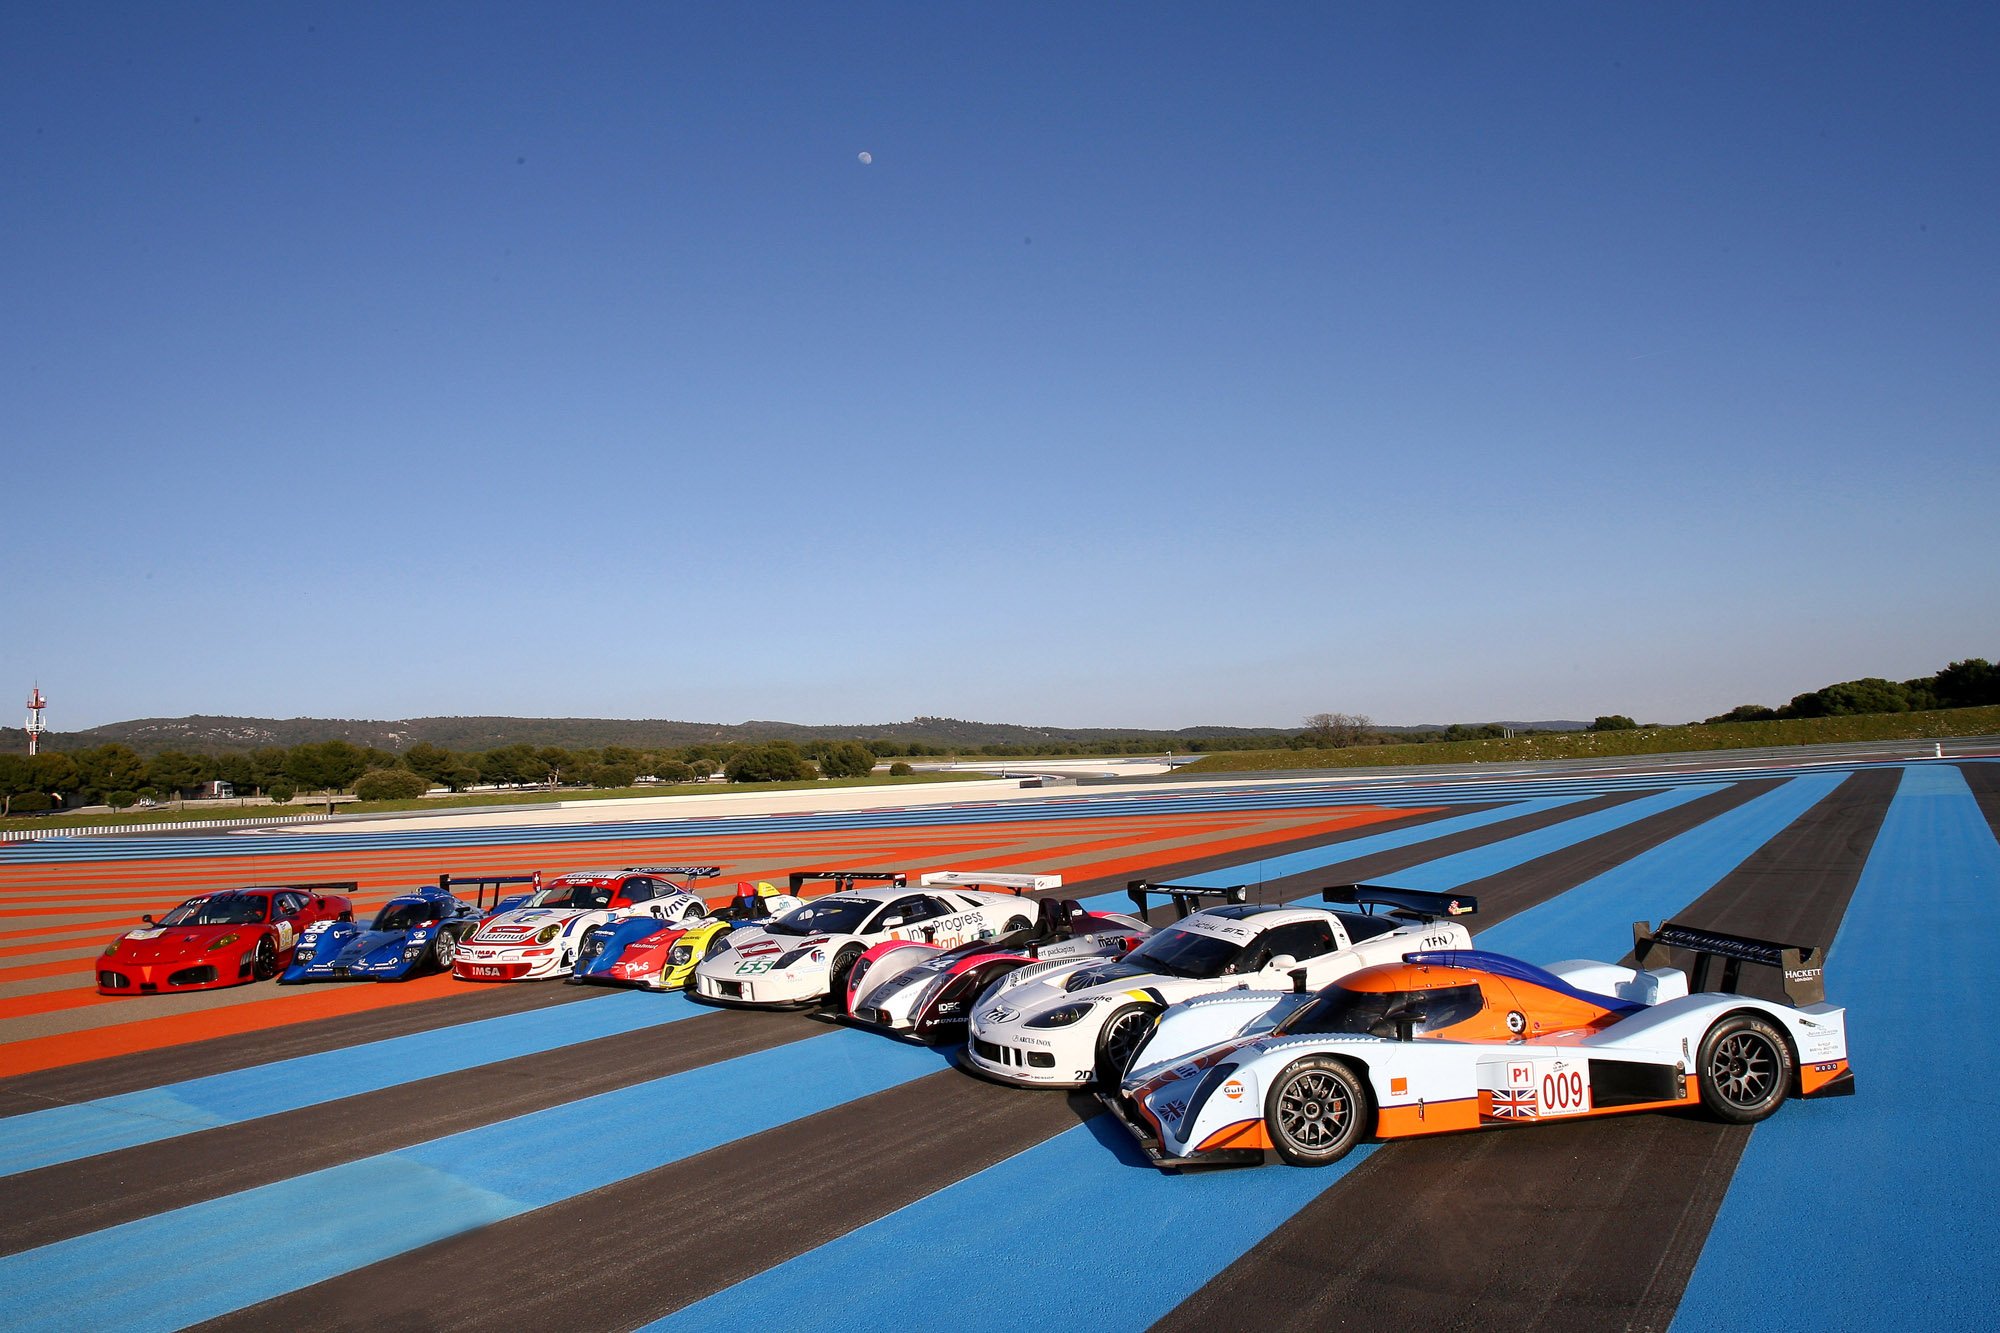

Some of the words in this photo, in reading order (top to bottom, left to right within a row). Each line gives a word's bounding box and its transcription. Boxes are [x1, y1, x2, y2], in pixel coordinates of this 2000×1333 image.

[1425, 936, 1448, 948] TFN
[1047, 946, 1076, 957] packaging
[472, 967, 500, 976] IMSA
[740, 961, 770, 973] 55
[1785, 969, 1822, 978] HACKETT
[1513, 1067, 1529, 1083] P1
[1223, 1085, 1245, 1094] Gulf
[1543, 1071, 1583, 1110] 009
